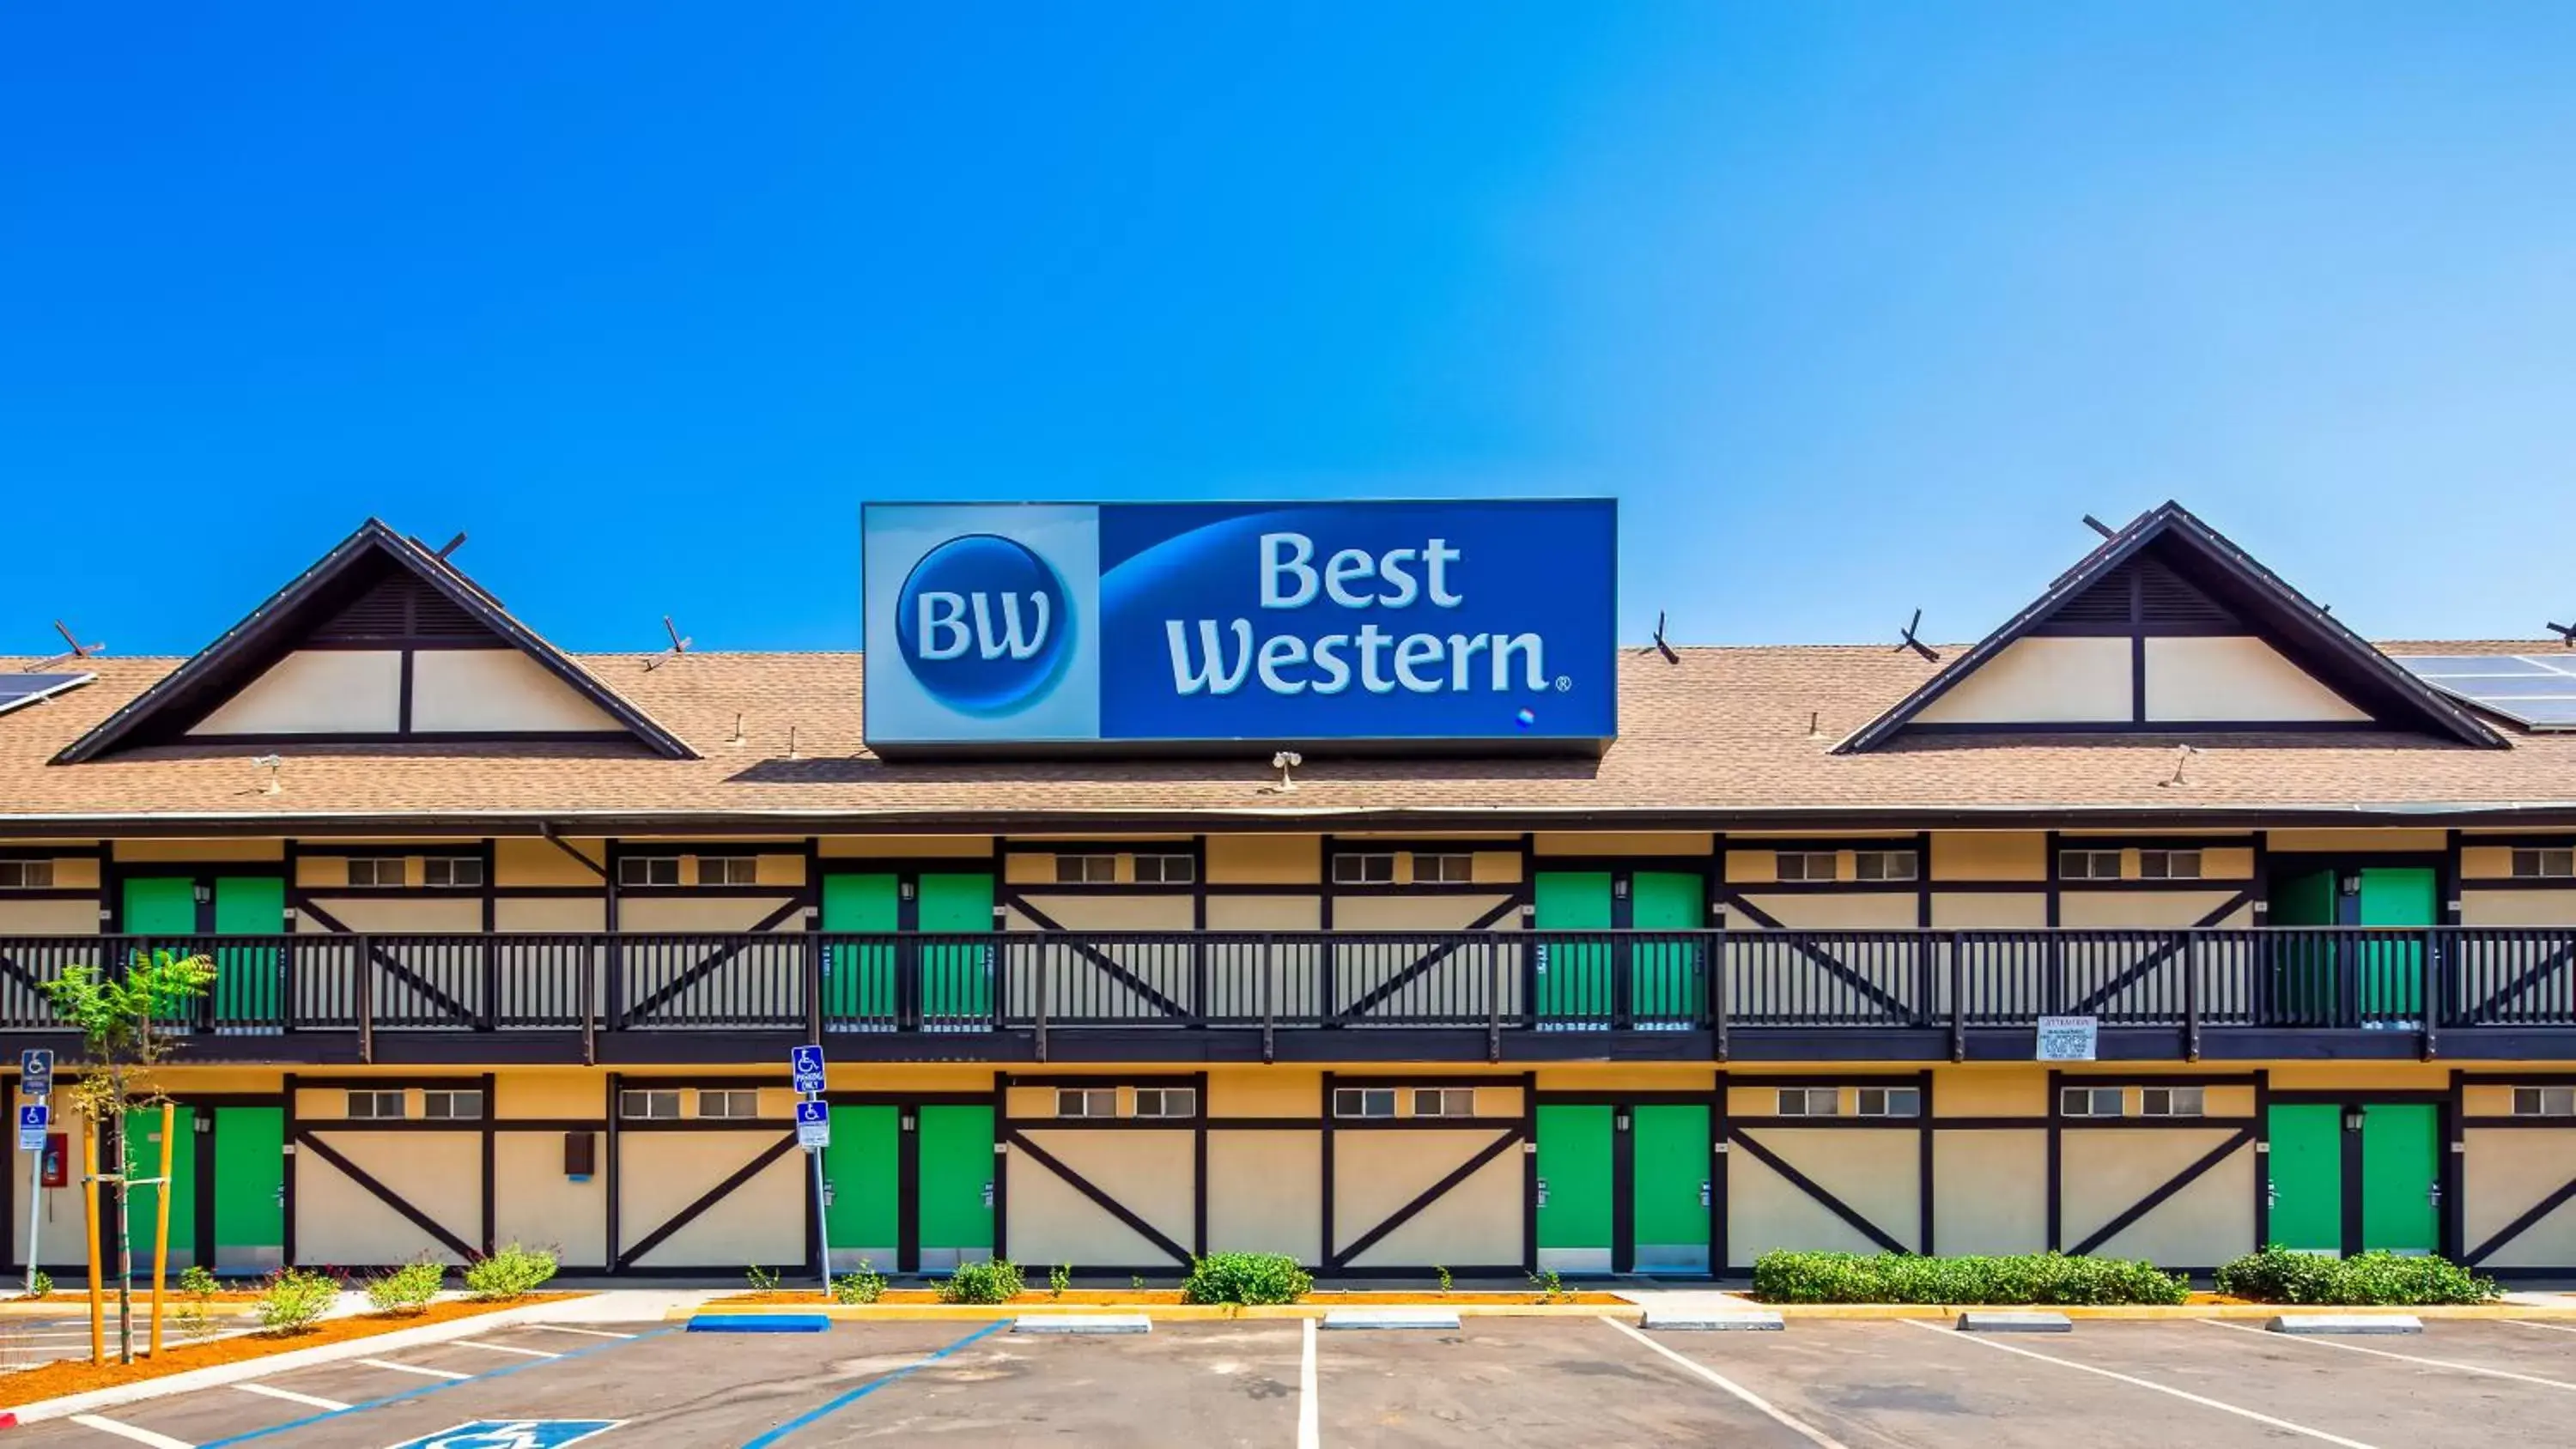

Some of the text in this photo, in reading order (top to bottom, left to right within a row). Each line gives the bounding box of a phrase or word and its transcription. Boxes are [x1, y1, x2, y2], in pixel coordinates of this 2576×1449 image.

[1260, 532, 1463, 609] Best
[918, 591, 1050, 660] BW
[1165, 618, 1550, 694] Western
